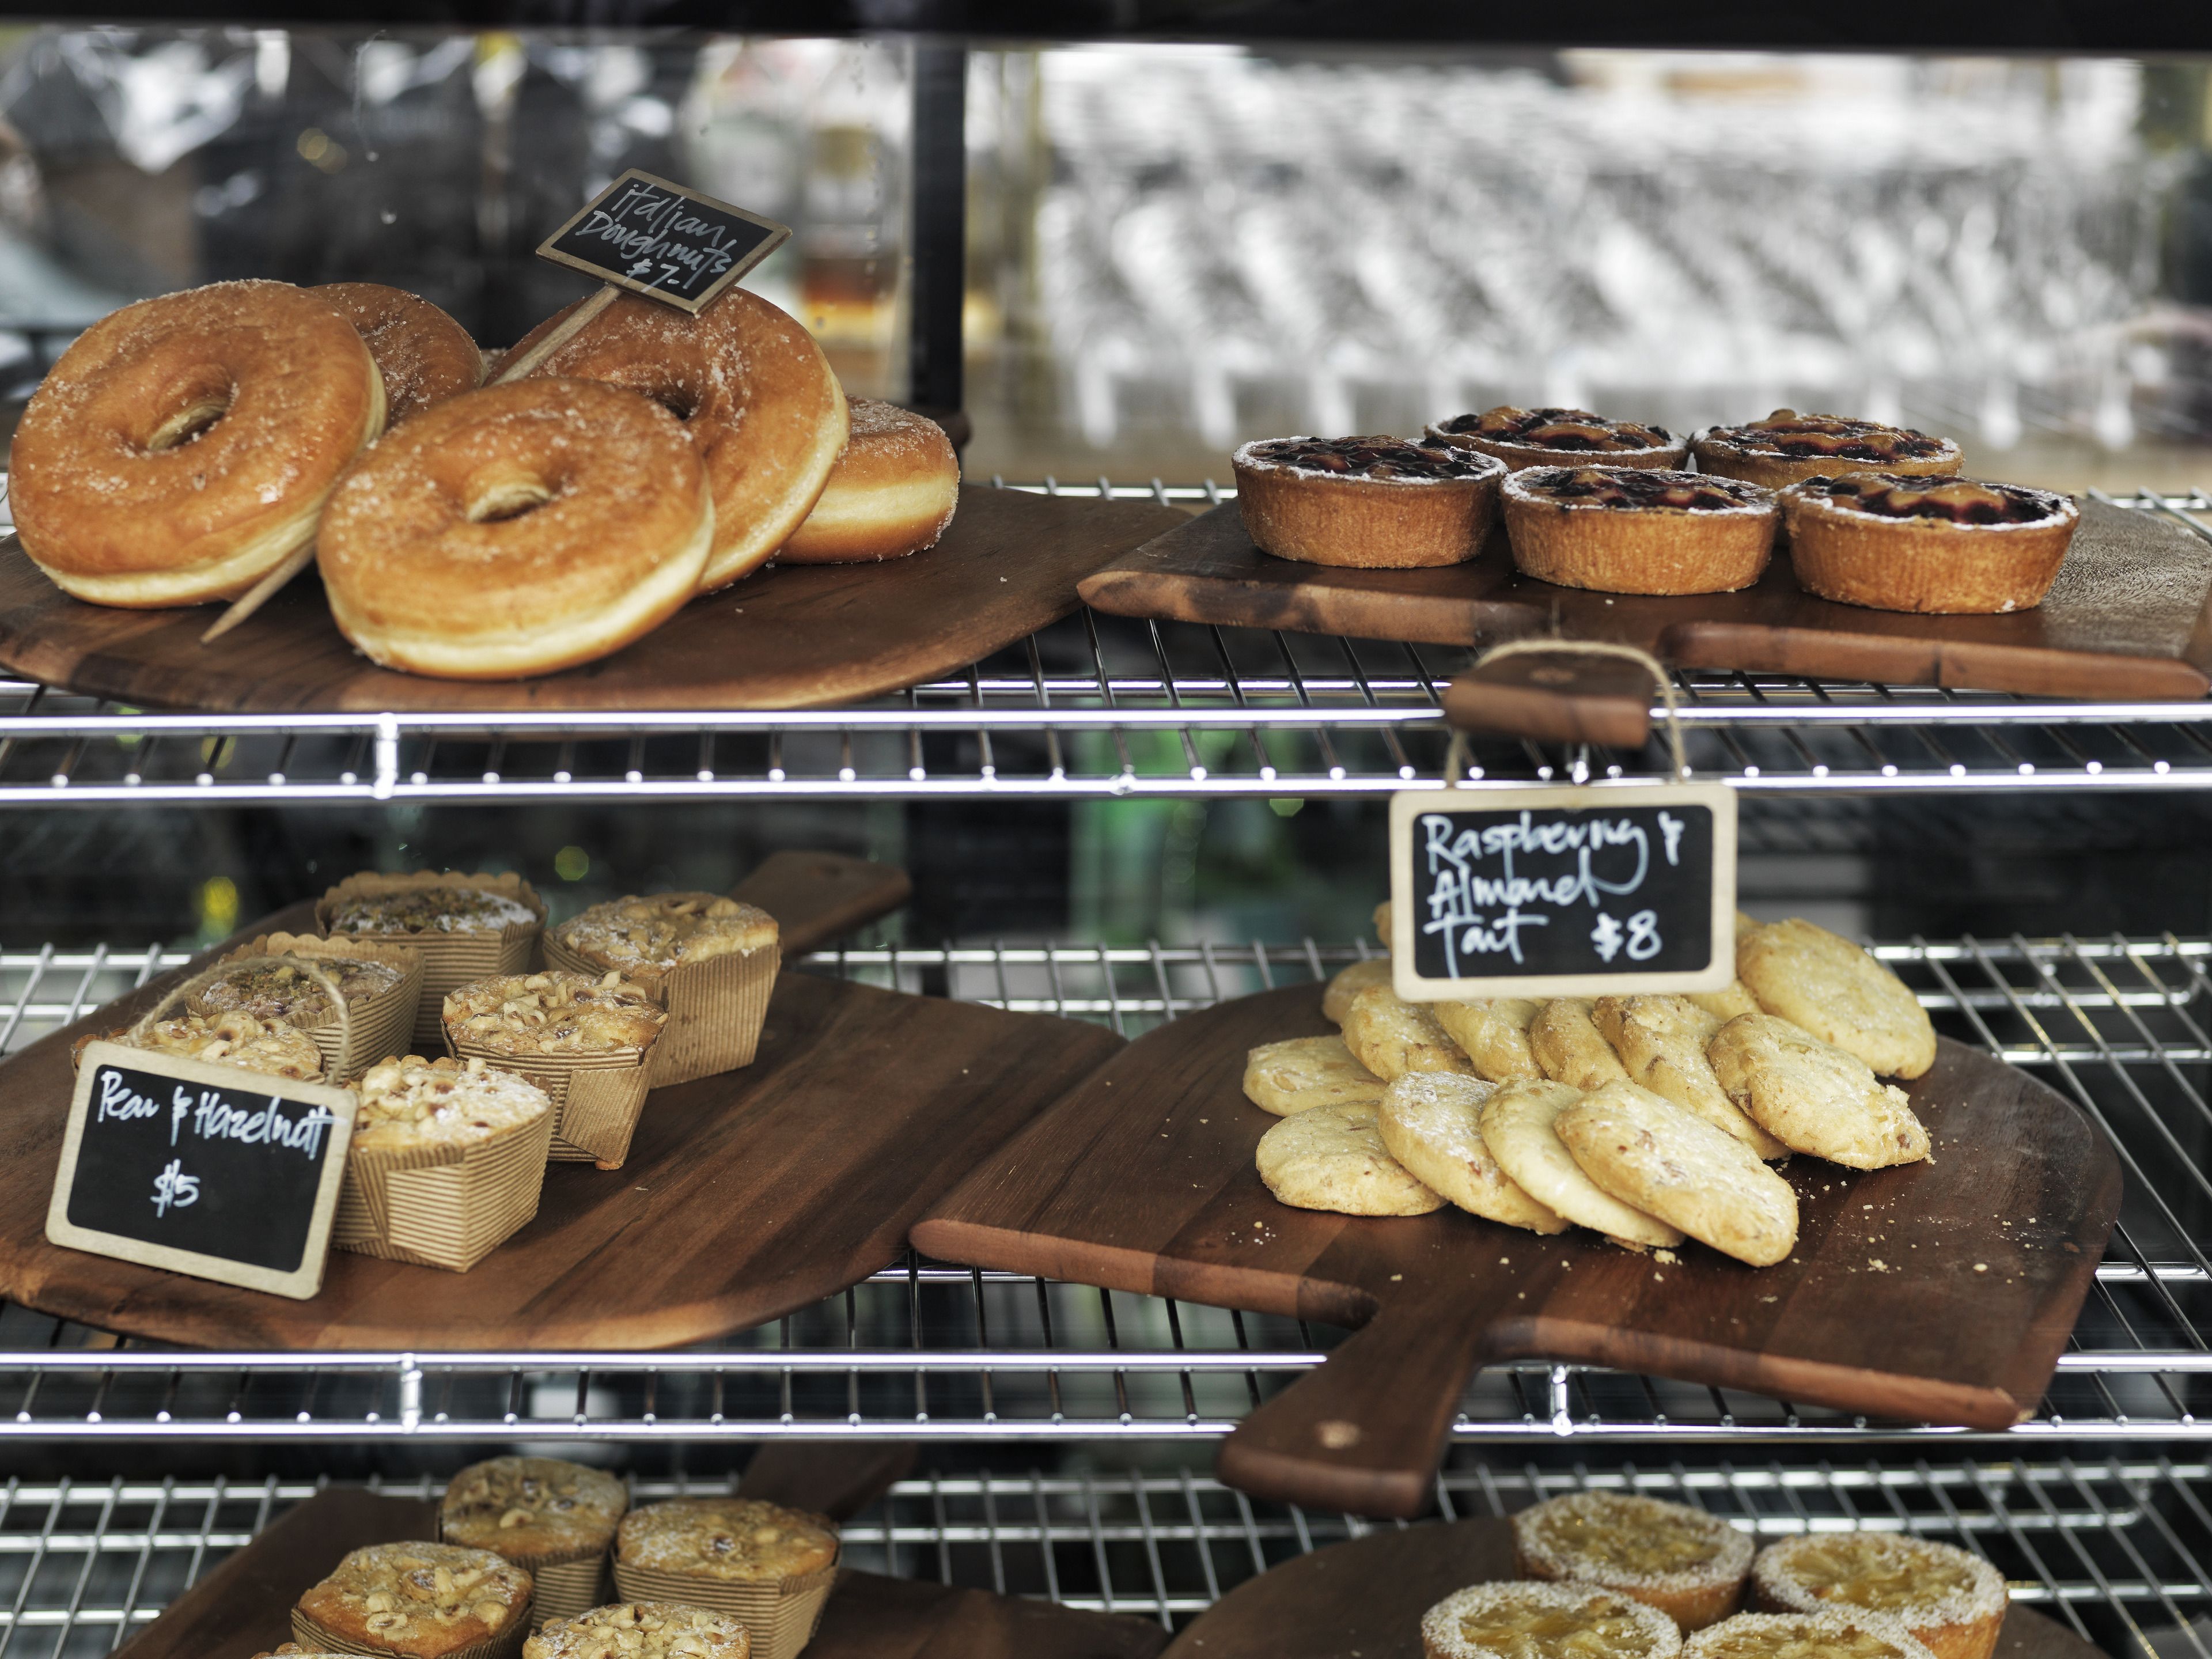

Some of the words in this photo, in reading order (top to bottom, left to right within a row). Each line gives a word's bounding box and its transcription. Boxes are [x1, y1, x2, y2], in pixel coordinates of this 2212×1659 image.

[575, 210, 737, 290] Doughnuts
[1422, 810, 1649, 895] Raspberry
[1427, 846, 1600, 919] Almond
[1423, 907, 1550, 979] Tart
[1590, 909, 1662, 963] $8
[97, 1070, 160, 1123] Pear
[150, 1158, 201, 1218] $5
